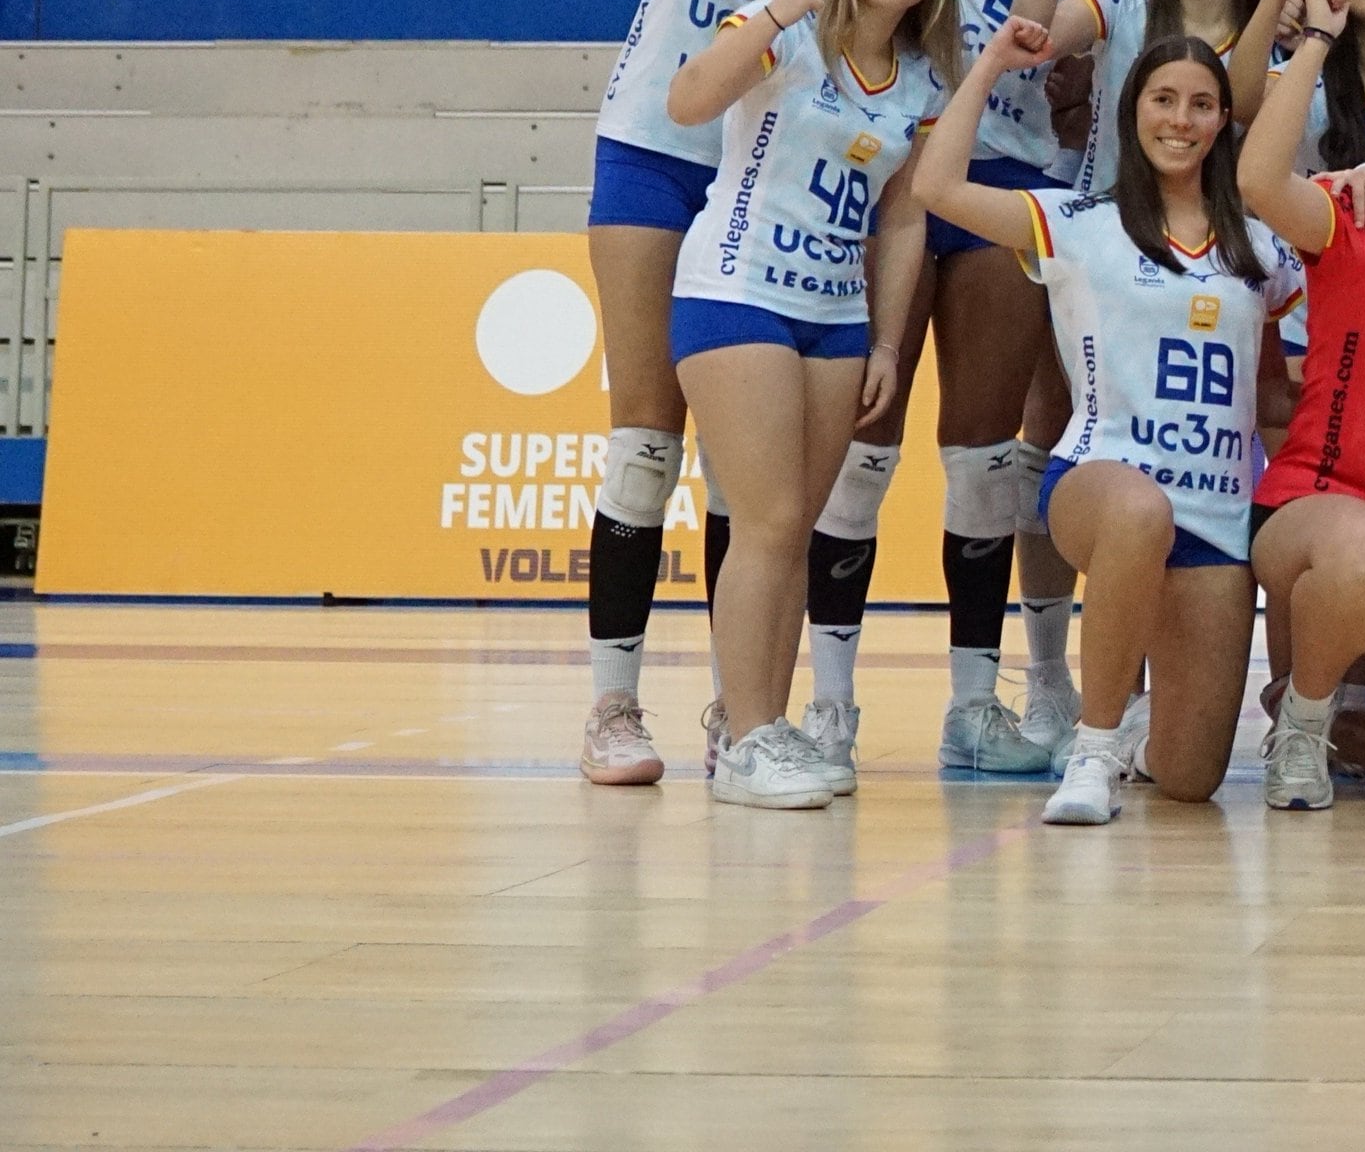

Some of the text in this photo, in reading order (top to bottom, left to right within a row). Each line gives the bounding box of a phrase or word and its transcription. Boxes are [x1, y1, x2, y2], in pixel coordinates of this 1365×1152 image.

[719, 110, 779, 277] cvleganes.com
[808, 157, 870, 233] 48
[1066, 334, 1097, 464] eganes.com
[1130, 413, 1243, 461] uc3m
[441, 483, 700, 532] FEMENA
